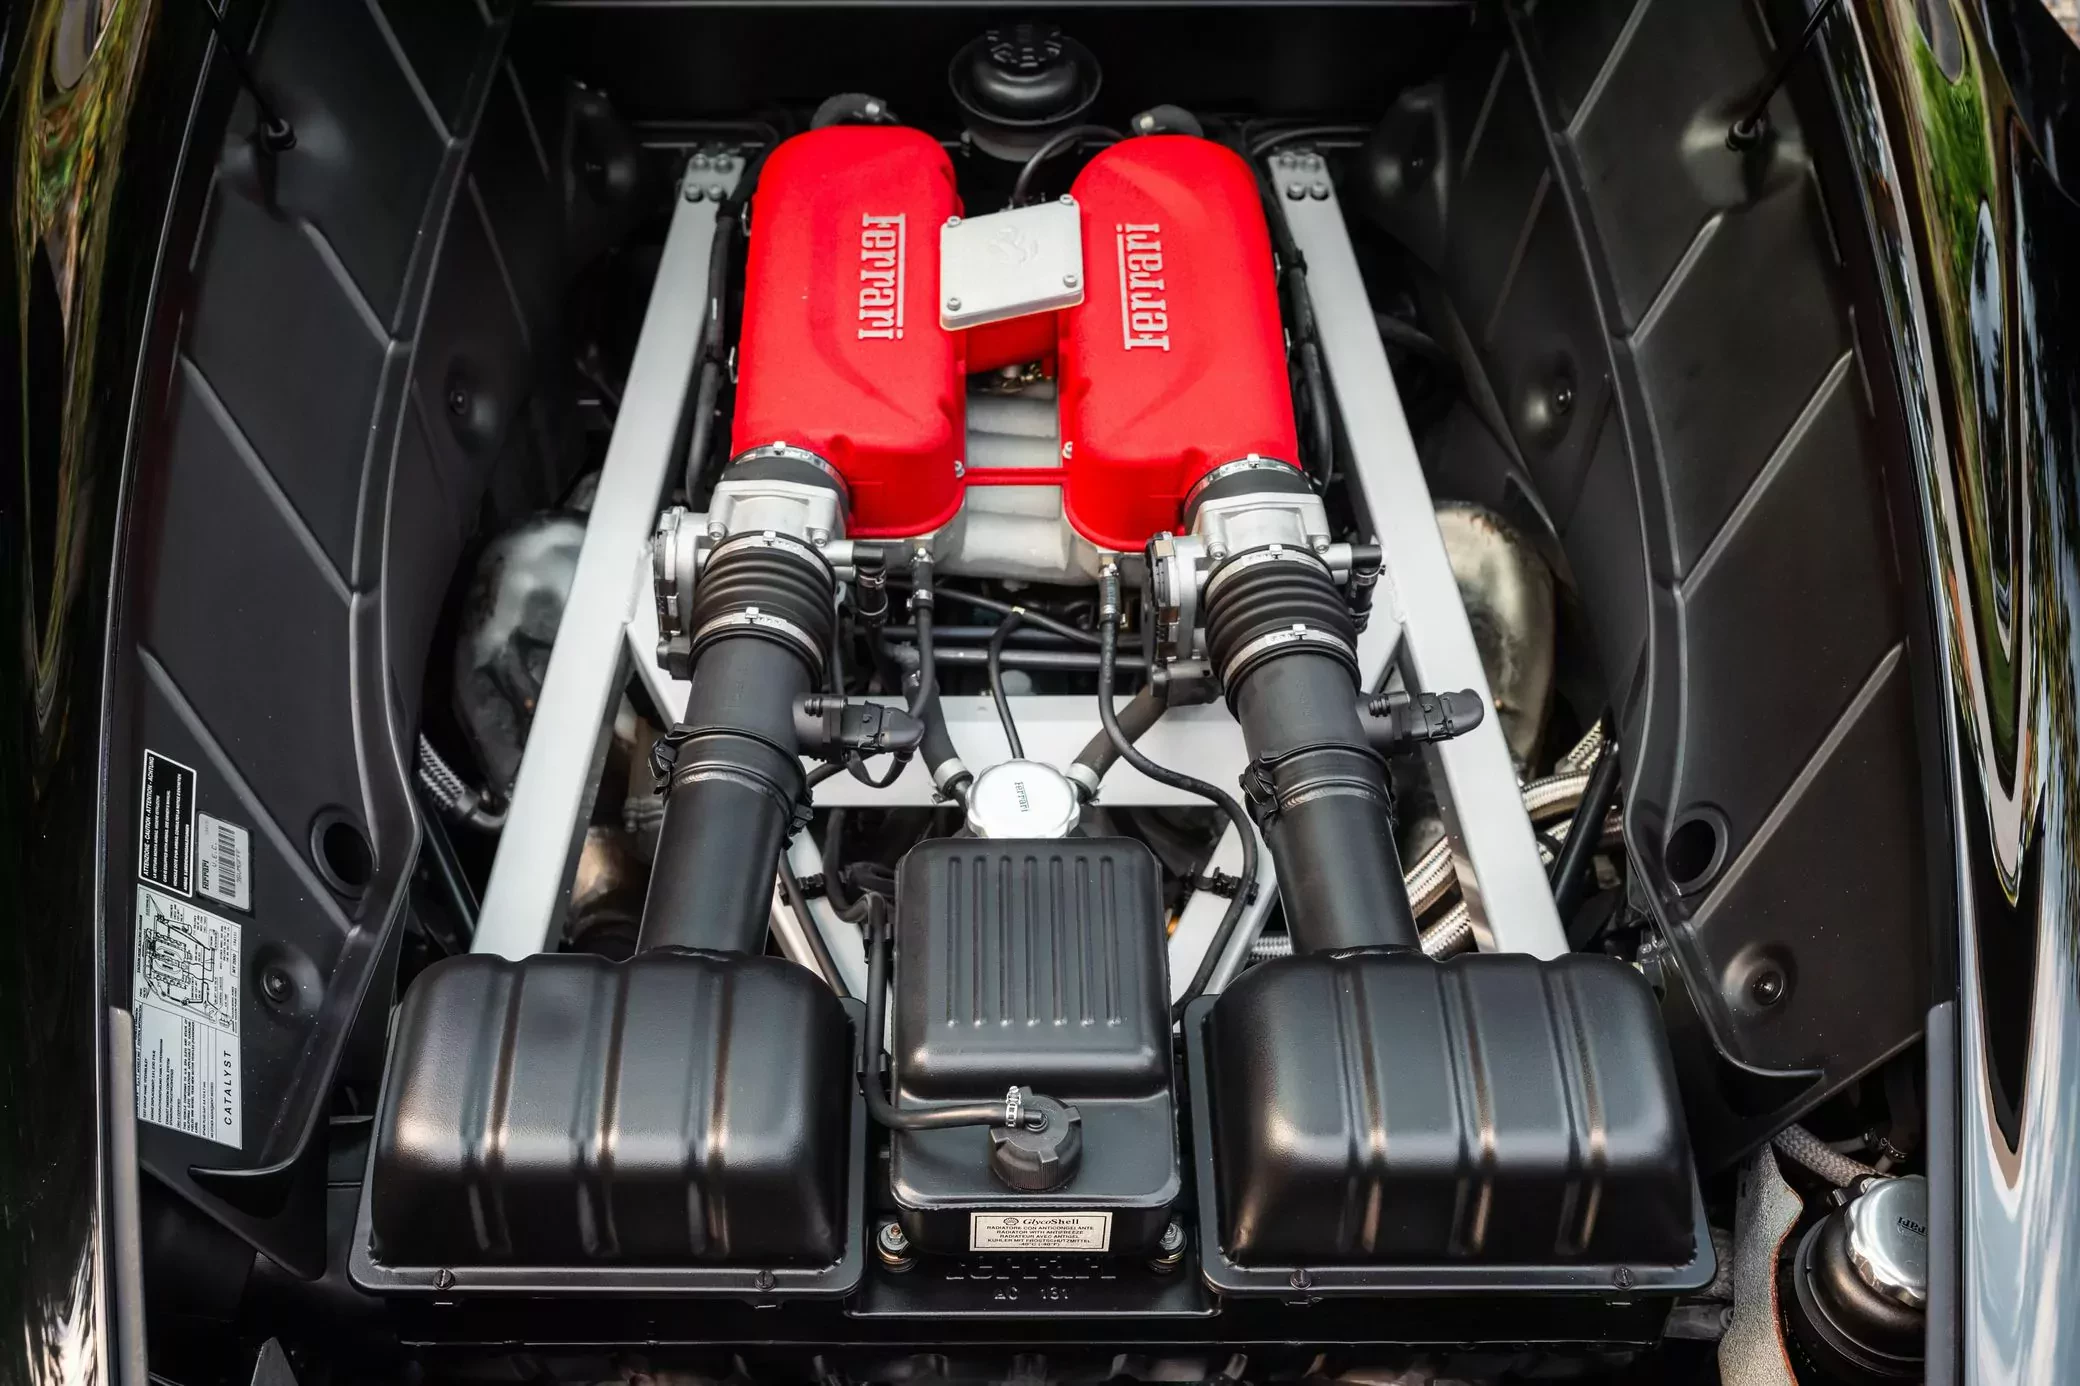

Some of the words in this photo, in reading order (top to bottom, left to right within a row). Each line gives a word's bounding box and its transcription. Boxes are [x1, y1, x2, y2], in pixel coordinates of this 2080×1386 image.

[858, 212, 906, 340] Ferrari
[1116, 223, 1170, 351] Ferrari
[1014, 781, 1030, 813] Ferrari
[224, 1050, 232, 1125] CATALYST
